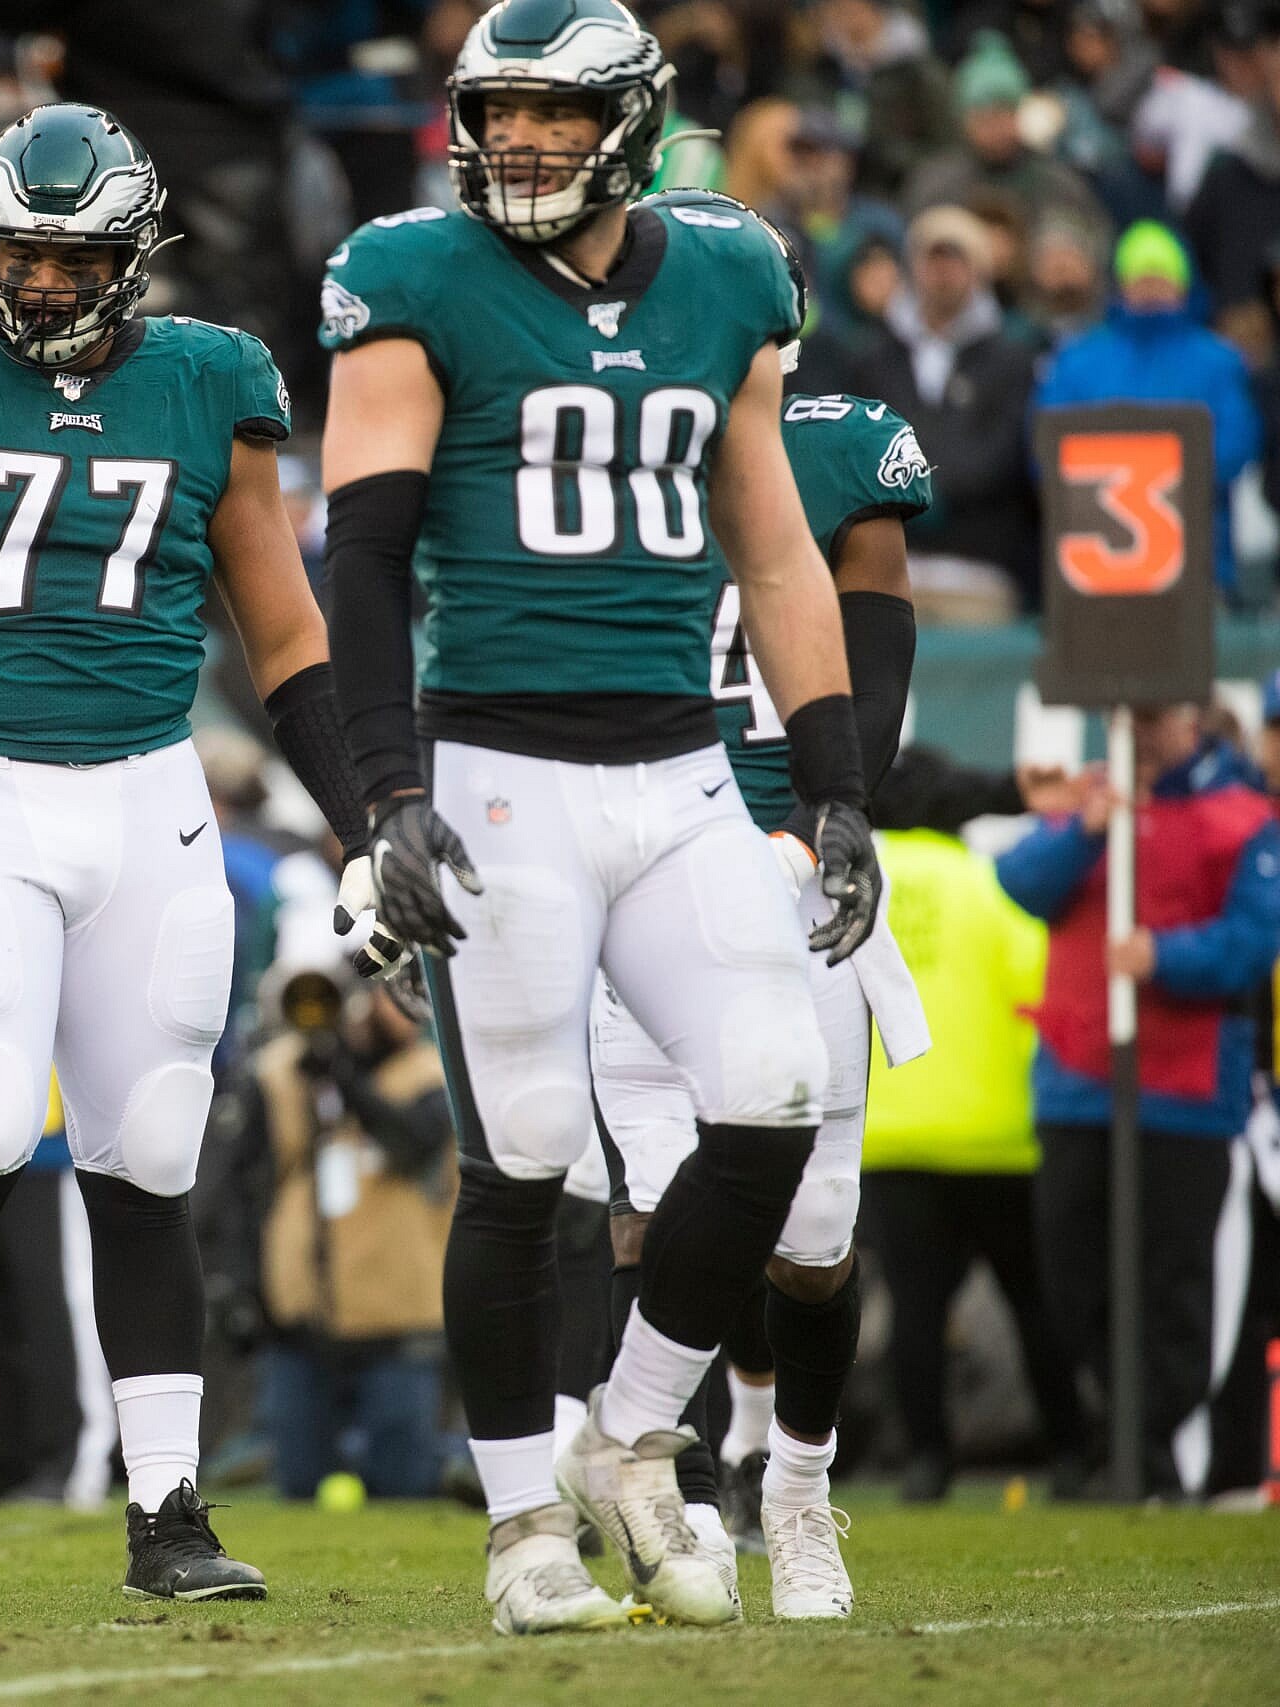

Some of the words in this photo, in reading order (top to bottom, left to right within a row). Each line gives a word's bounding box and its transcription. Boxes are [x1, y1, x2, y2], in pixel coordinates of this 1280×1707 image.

[48, 412, 104, 433] EAGLES
[516, 384, 718, 559] 88
[1058, 432, 1183, 594] 3
